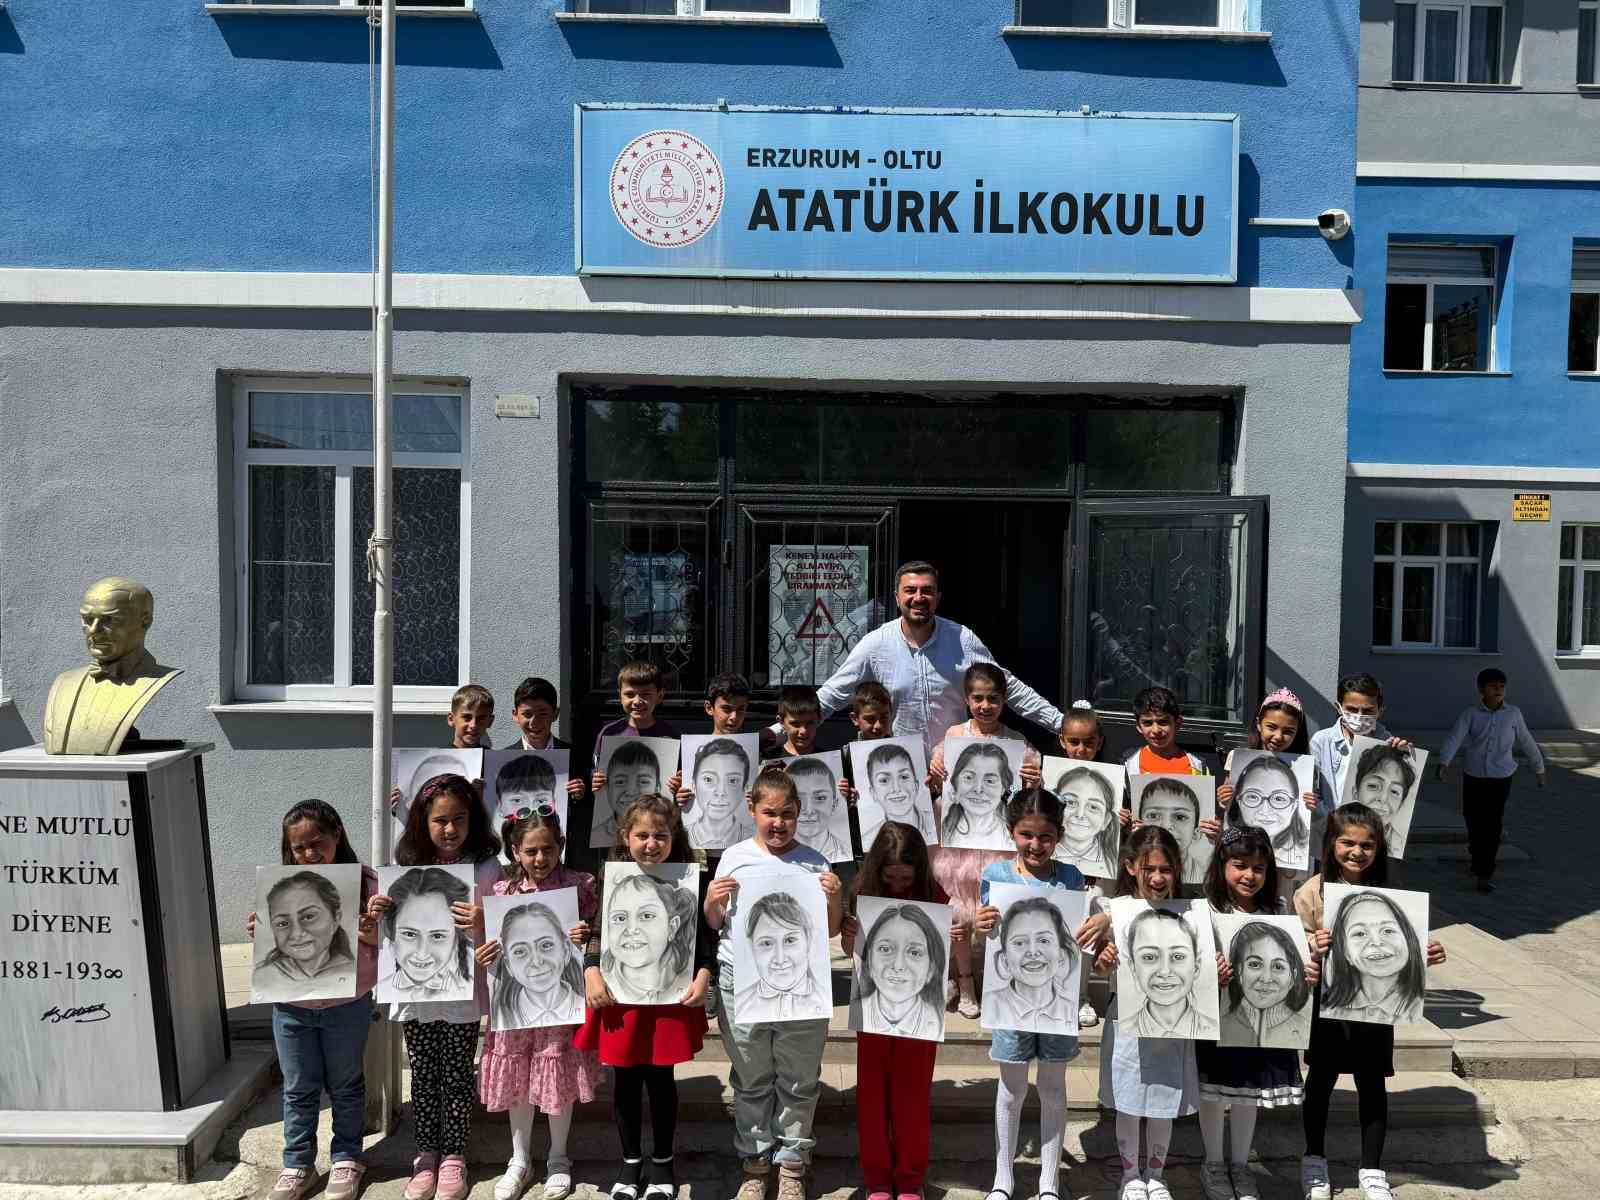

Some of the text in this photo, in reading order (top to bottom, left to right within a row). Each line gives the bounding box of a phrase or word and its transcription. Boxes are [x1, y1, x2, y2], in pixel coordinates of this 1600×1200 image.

[747, 148, 860, 168] ERZURUM
[883, 151, 942, 169] OLTU
[747, 177, 1205, 238] ATATÜRK İLKOKULU
[36, 816, 132, 836] MUTLU
[4, 860, 119, 885] TÜRKÜM
[12, 909, 112, 934] DİYENE
